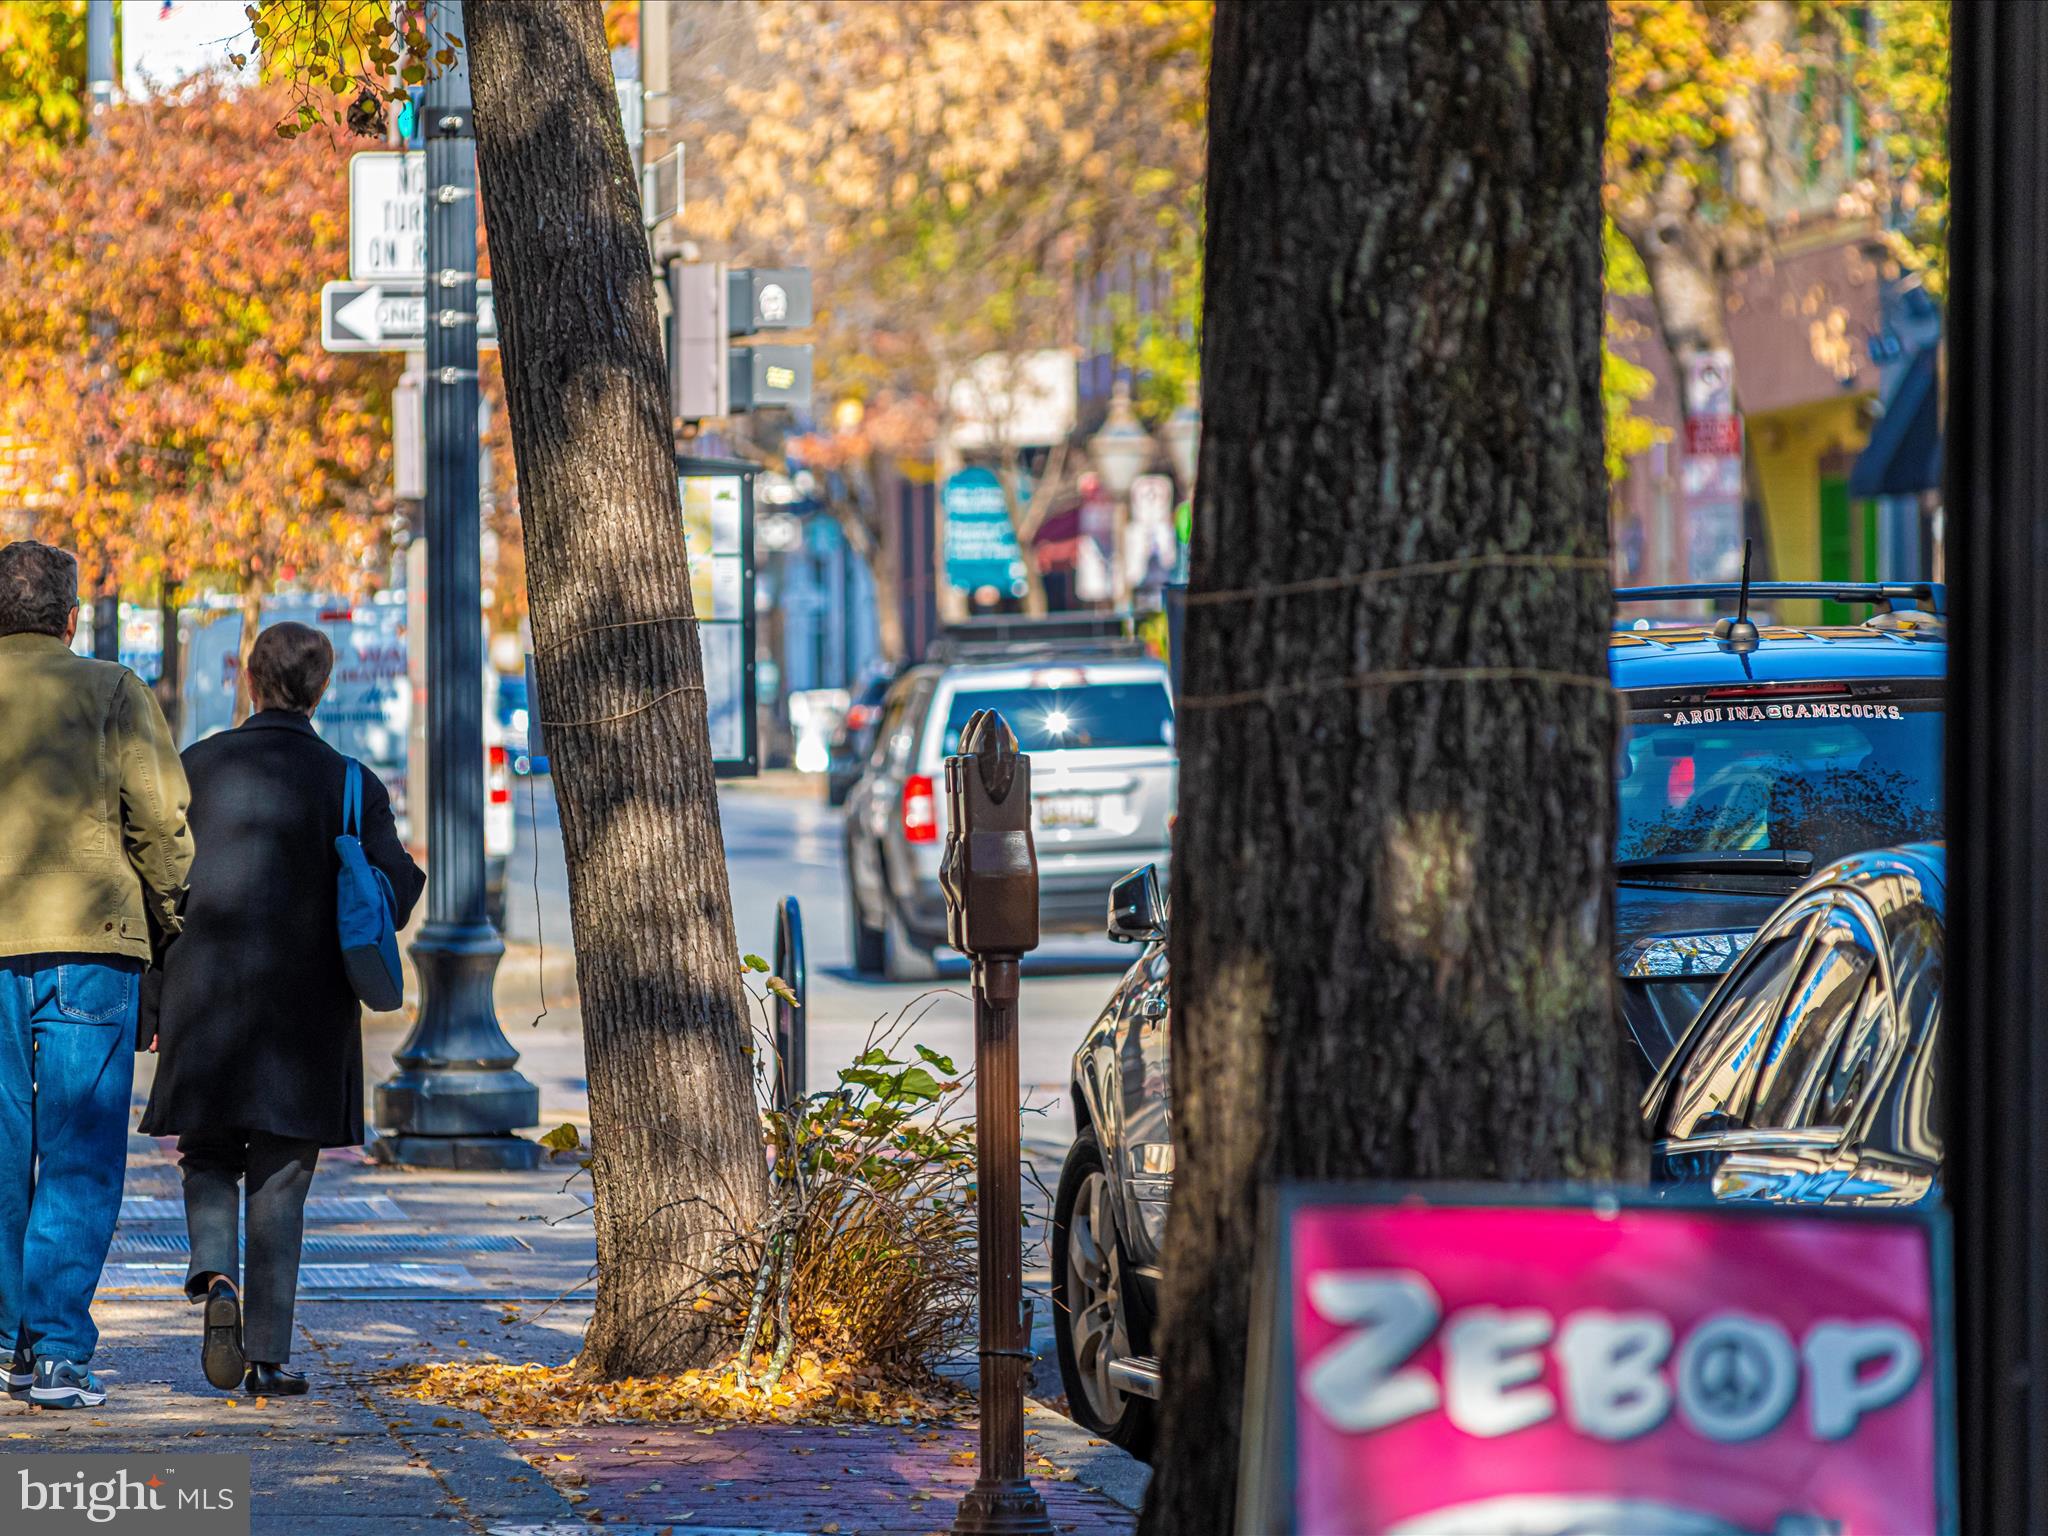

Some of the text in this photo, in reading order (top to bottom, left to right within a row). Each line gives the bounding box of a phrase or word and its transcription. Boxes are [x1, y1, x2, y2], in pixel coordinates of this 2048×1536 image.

[383, 200, 421, 231] TUR
[375, 301, 420, 324] ONE
[1664, 703, 1900, 726] AROINA GAMECOCKS
[1303, 1268, 1923, 1441] ZEBOP
